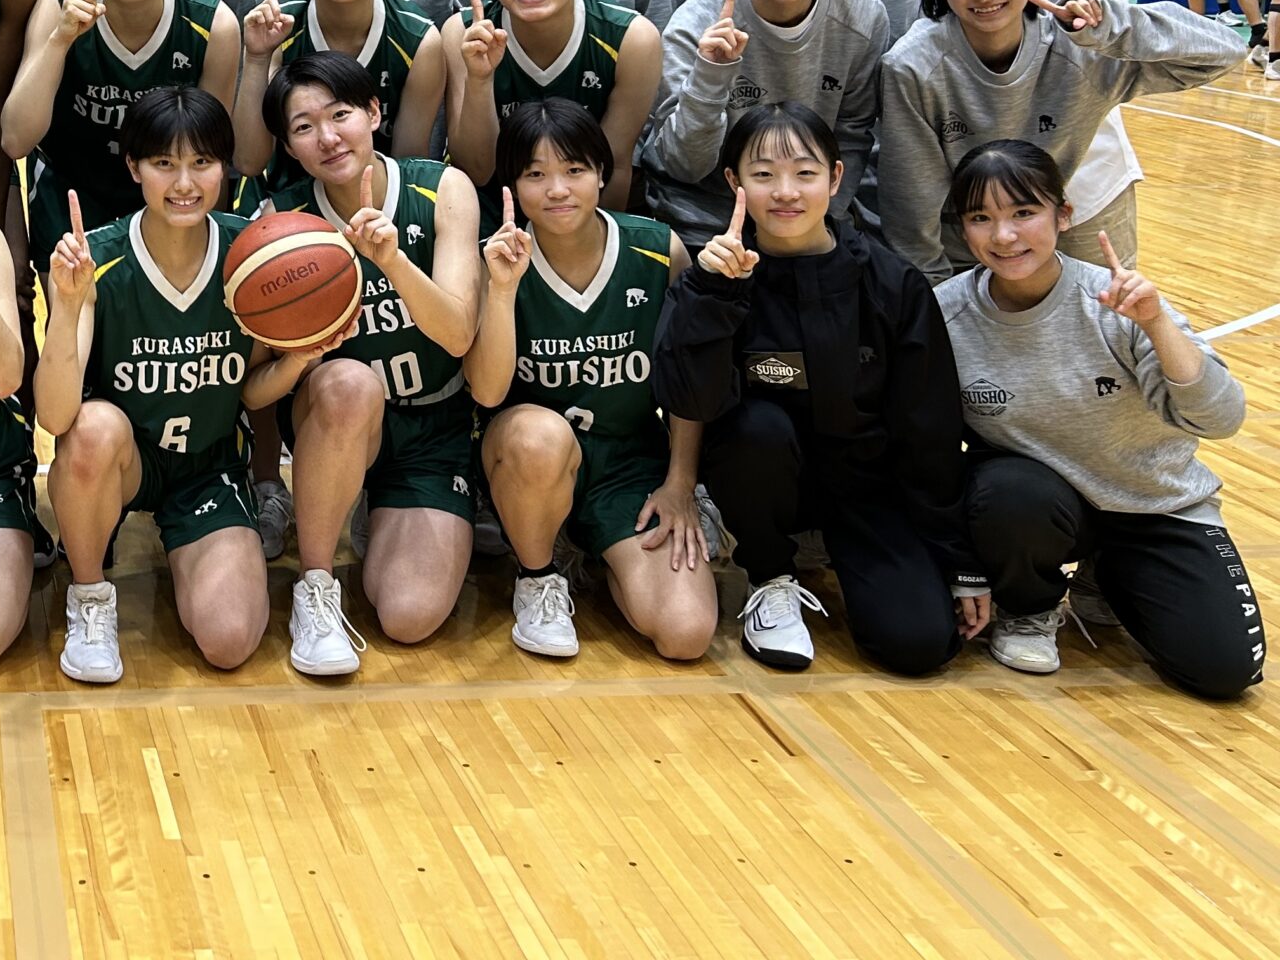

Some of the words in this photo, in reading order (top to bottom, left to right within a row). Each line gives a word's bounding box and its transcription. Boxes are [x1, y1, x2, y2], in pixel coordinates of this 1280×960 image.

[259, 261, 320, 297] molten
[131, 330, 231, 356] KURASHIKI
[530, 330, 636, 356] KURASHIKI
[113, 352, 246, 394] SUISHO
[370, 351, 423, 401] 10
[517, 350, 651, 388] SUISHO
[756, 364, 794, 377] SUISHO
[960, 389, 1007, 405] SUISHO
[158, 415, 192, 454] 6
[1205, 526, 1245, 578] THE
[1235, 583, 1265, 680] PAIN
